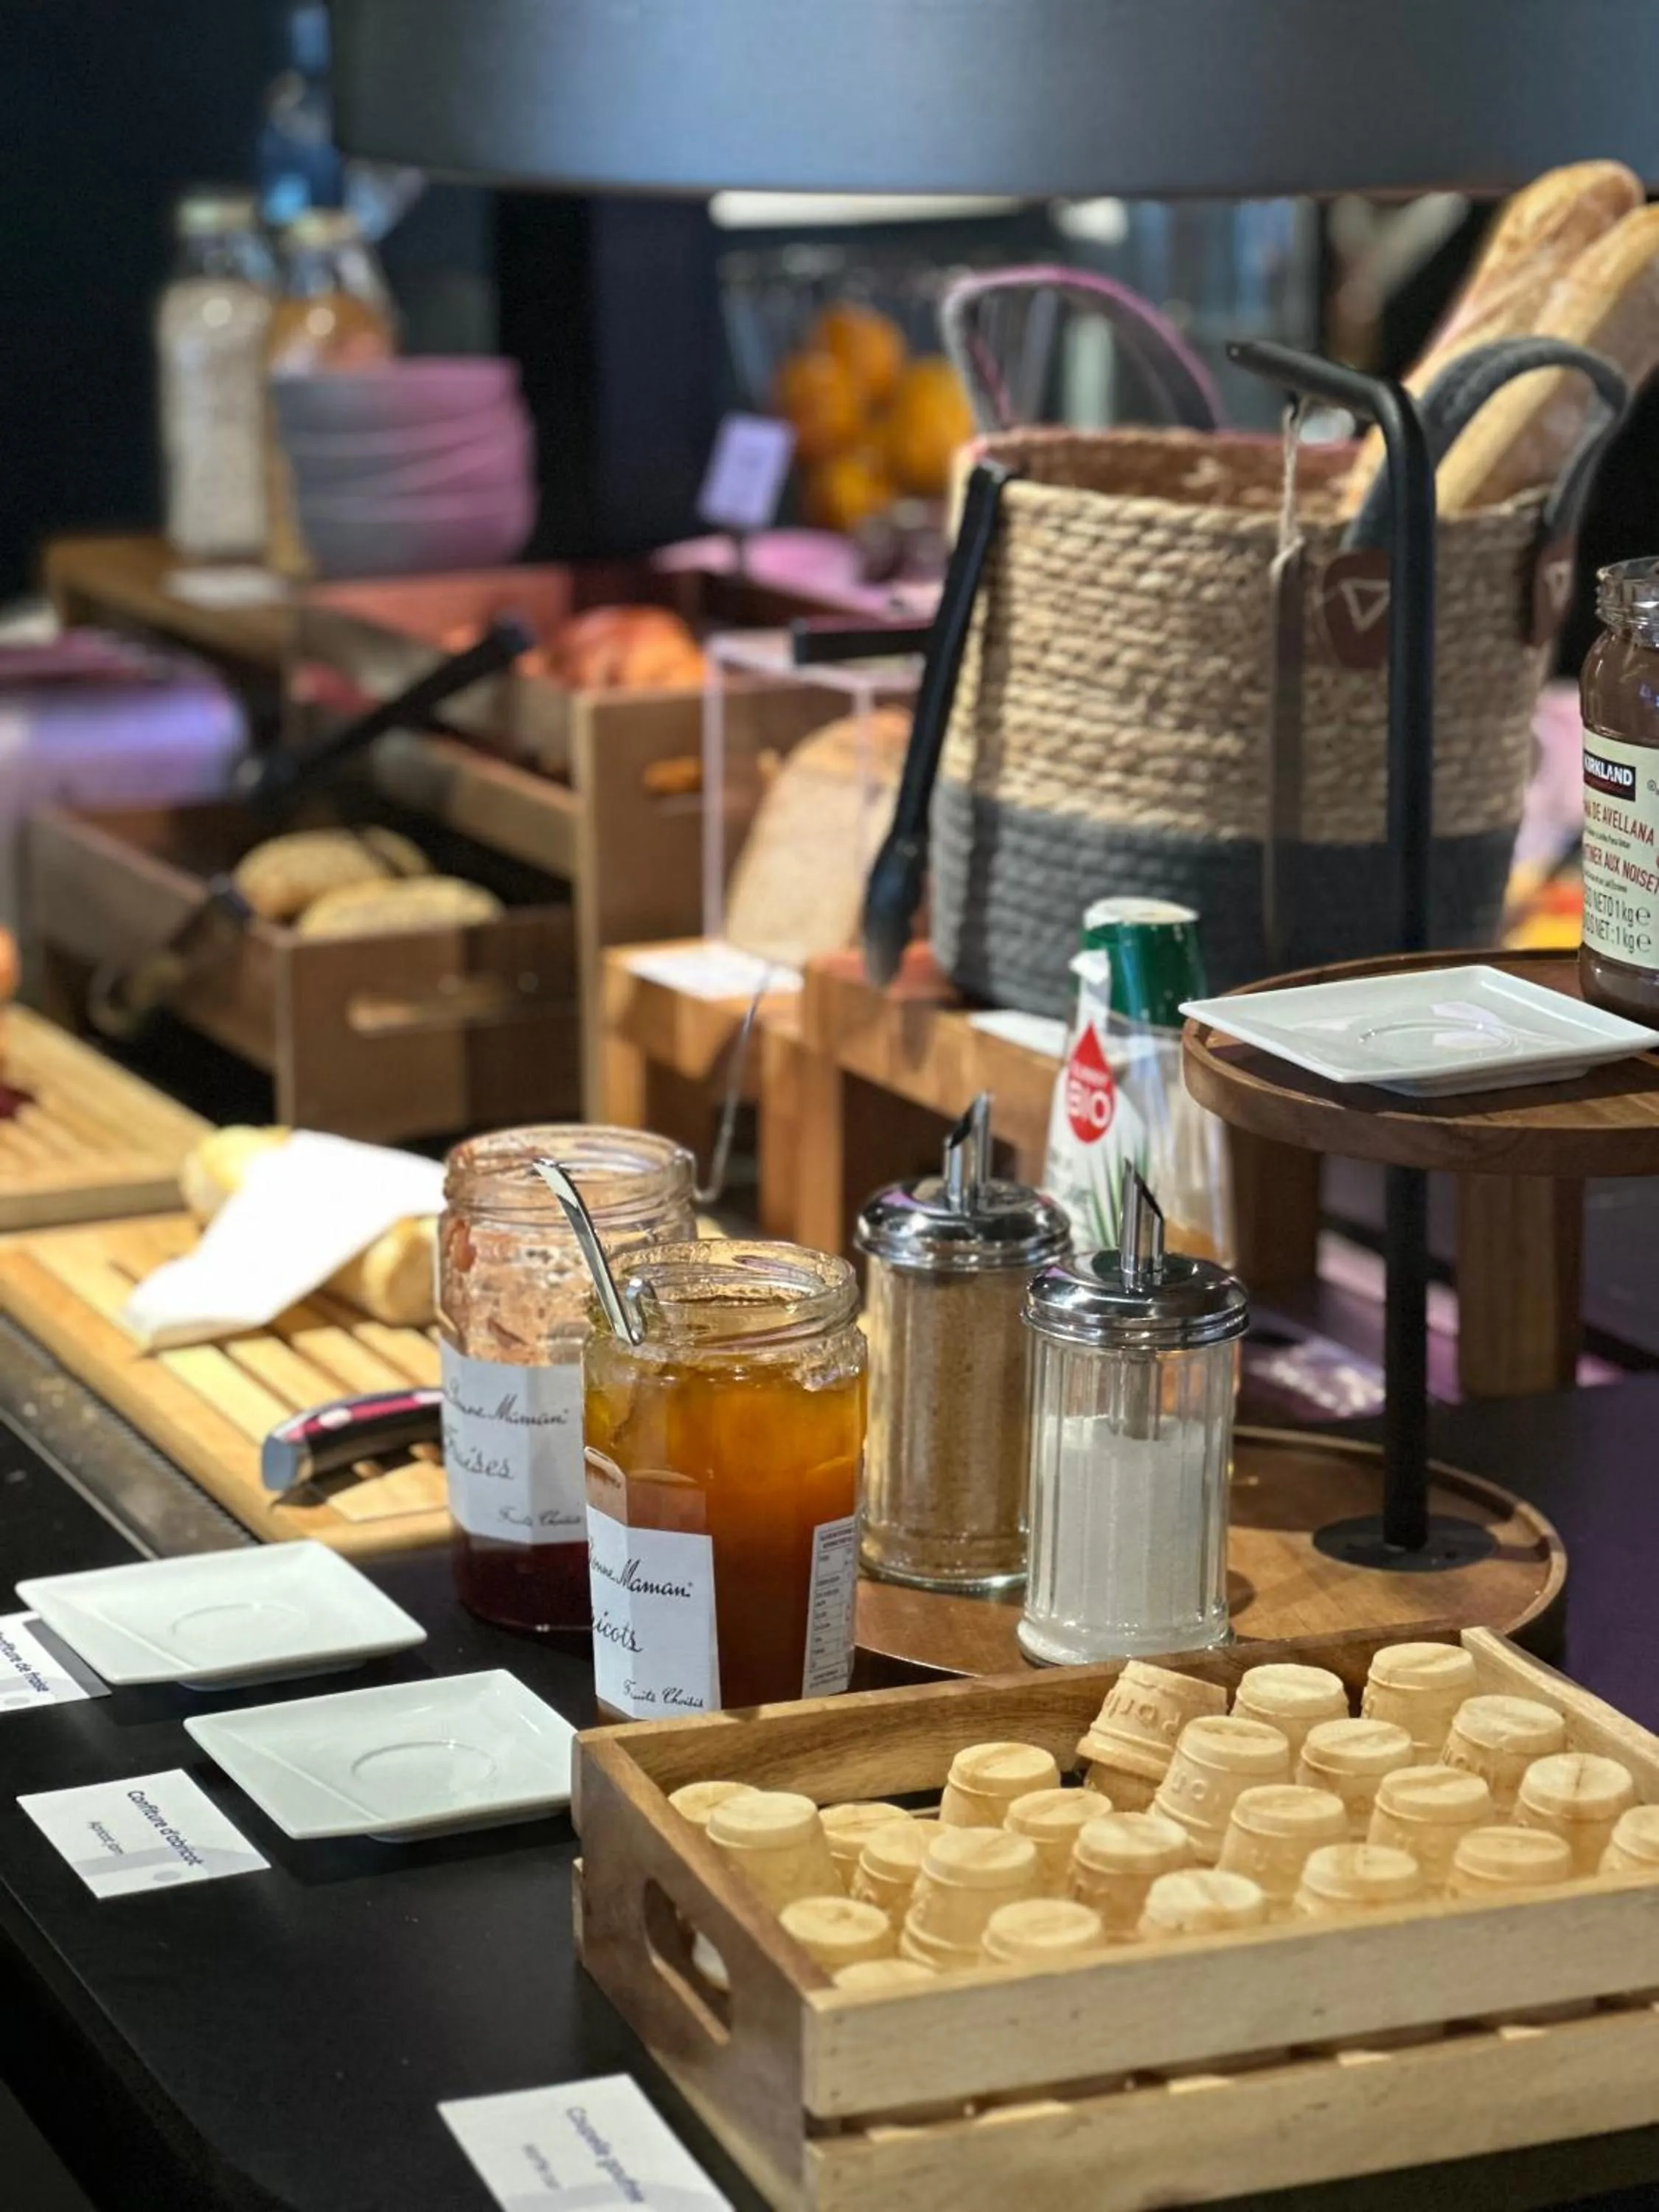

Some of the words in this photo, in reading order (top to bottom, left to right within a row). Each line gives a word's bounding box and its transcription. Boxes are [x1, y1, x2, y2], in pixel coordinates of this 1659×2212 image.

[1602, 805, 1654, 846] AVELLANA
[616, 1558, 691, 1598] Maman
[591, 1611, 644, 1652] icots
[127, 1790, 167, 1828] Confiture
